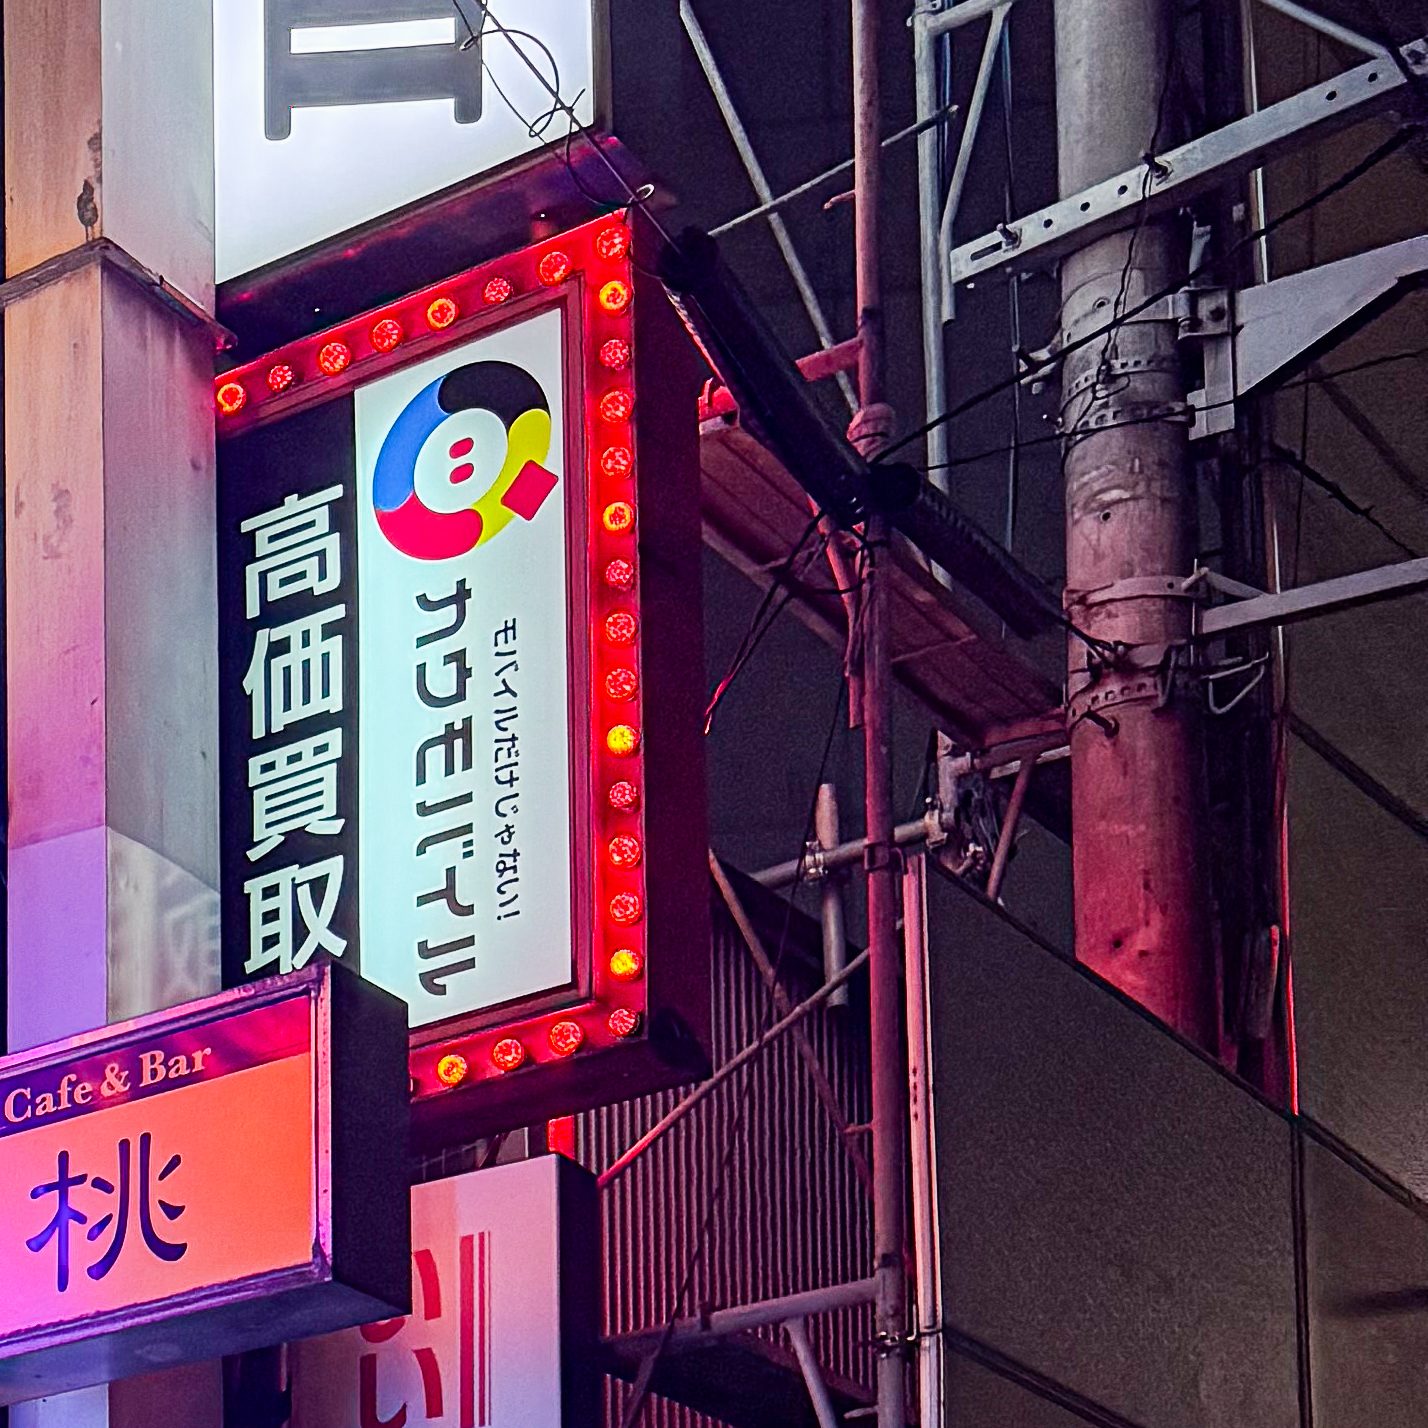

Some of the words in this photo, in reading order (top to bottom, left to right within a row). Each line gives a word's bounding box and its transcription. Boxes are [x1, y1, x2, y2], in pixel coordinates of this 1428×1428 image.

[238, 484, 349, 976] 高価買取
[415, 578, 476, 997] カウモバイル
[493, 617, 521, 922] モバイルだけじゃない!
[4, 1073, 93, 1124] Cafe
[101, 1064, 130, 1099] &
[138, 1045, 214, 1088] Bar
[26, 1131, 188, 1293] 桃
